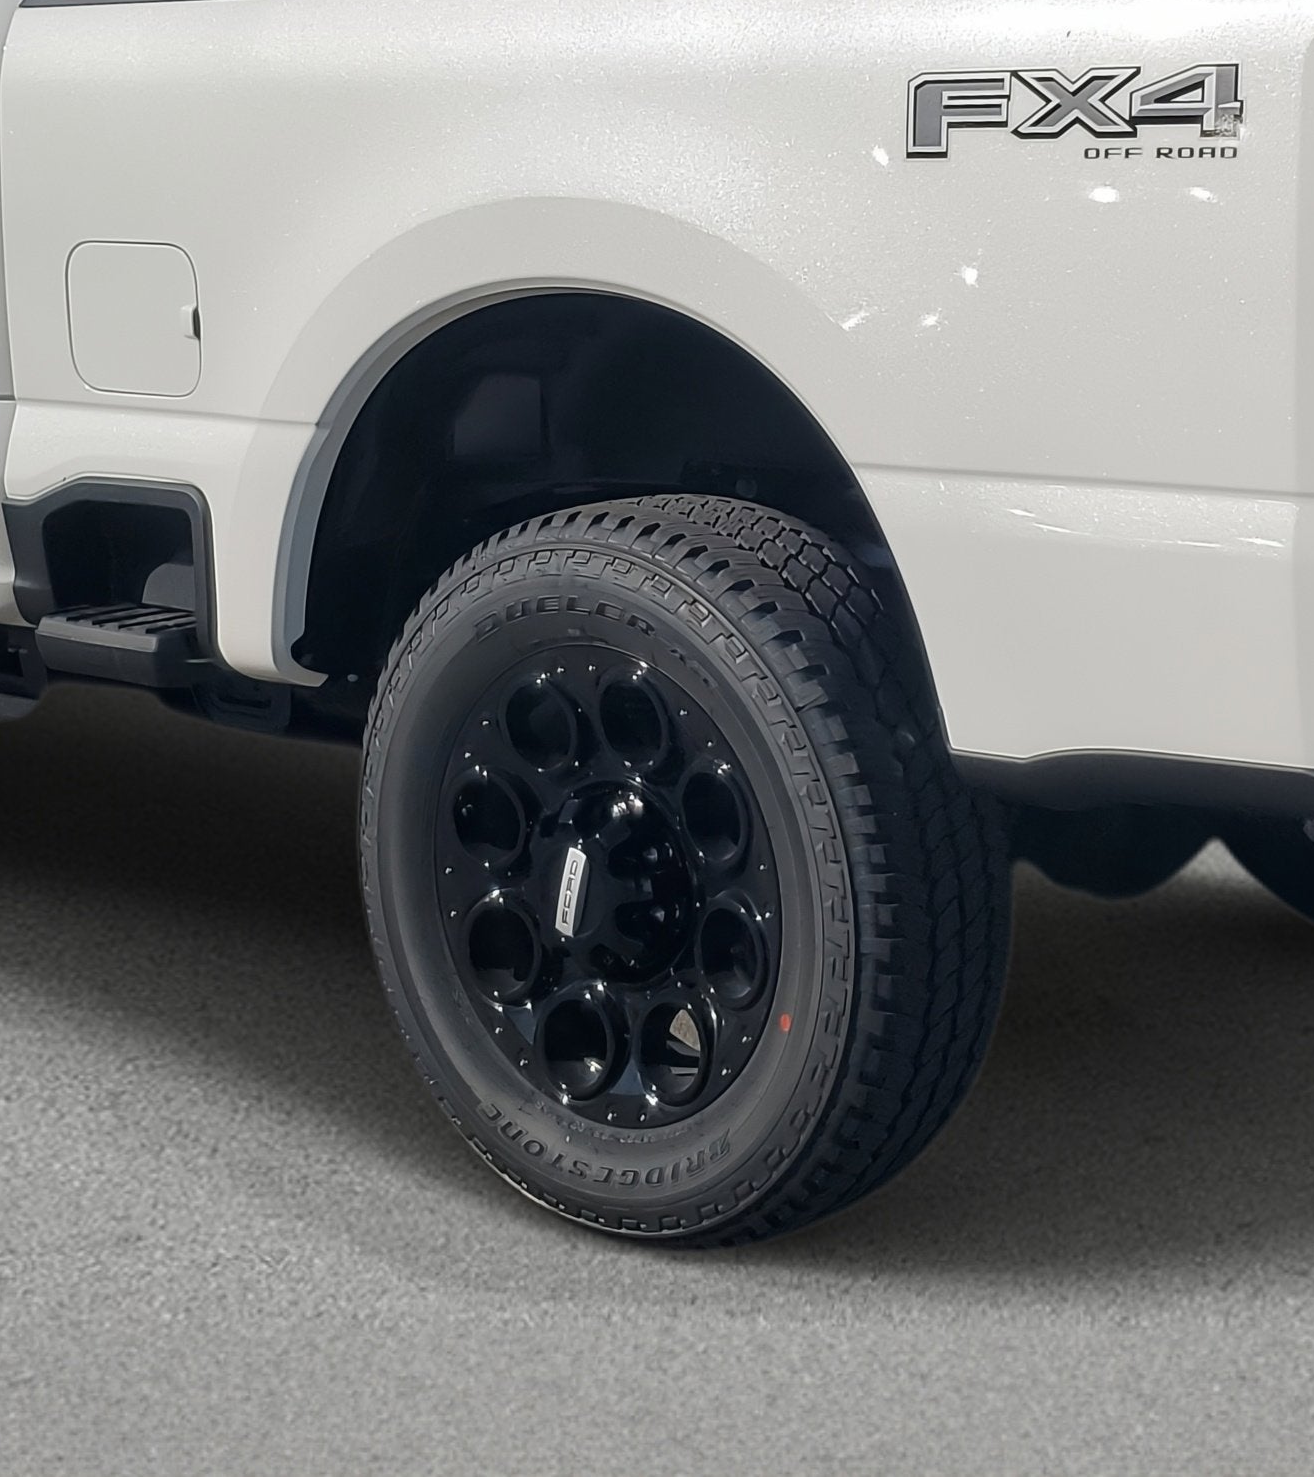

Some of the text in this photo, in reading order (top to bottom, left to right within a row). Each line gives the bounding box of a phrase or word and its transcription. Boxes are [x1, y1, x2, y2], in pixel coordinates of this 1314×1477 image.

[905, 62, 1244, 159] FX4
[1083, 145, 1238, 160] OFF ROAD
